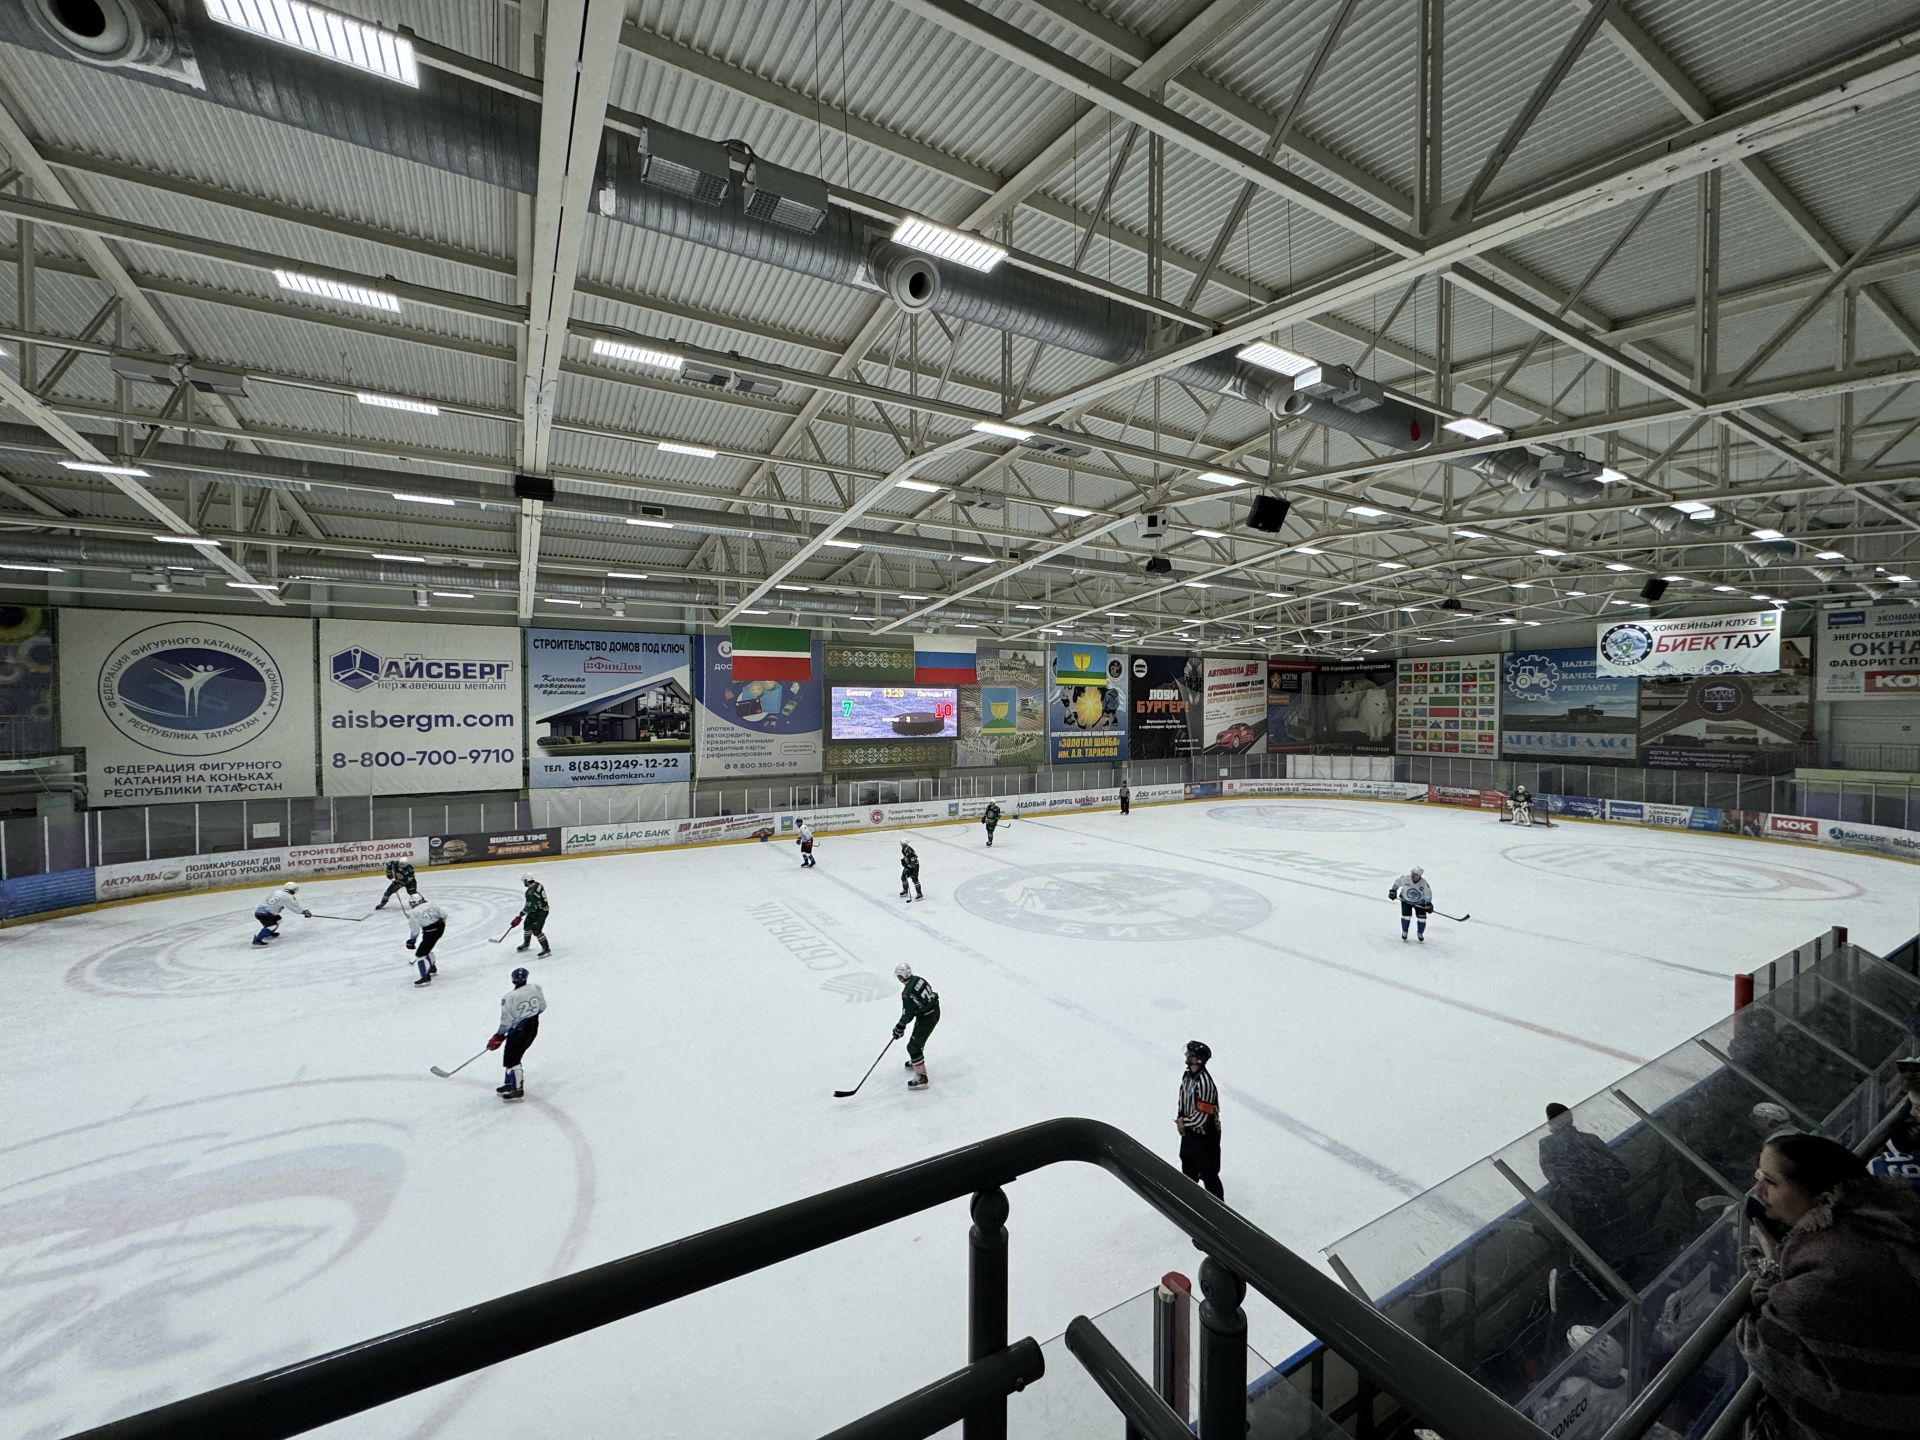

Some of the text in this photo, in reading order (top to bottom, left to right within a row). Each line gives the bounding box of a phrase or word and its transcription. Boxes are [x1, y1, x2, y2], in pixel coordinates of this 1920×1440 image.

[1652, 618, 1757, 632] ХОККЕЙНЫЙ КЛУБ
[533, 638, 685, 654] СТРОИТЕЛЬСТВО ДОМОВ ПОД КЛЮЧ
[1655, 633, 1772, 653] БИЕКТАУ
[1849, 640, 1920, 656] ОКНА
[384, 657, 510, 680] АЙСБЕРГ
[593, 661, 642, 672] ФинДом
[1829, 657, 1896, 668] ФАВОРИТ
[103, 637, 281, 709] ФЕДЕРАЦИЯ ФИГУРНОГО КАТАНИЯ НА КОНЬКАХ
[541, 674, 586, 683] Качество
[1207, 667, 1244, 678] АВТОШКОЛА
[377, 681, 461, 691] нержавеющий
[1208, 683, 1235, 691] АВТОШКОЛА
[1562, 684, 1617, 692] РЕЗУЛЬТАТ
[1149, 689, 1178, 700] ЛОВИ
[842, 700, 953, 718] 7 10
[127, 716, 260, 741] РЕСПУБЛИКА ТАТАРСТАН
[332, 710, 514, 733] aisbergm.com
[332, 748, 514, 768] 8-800-700-9710
[706, 751, 773, 759] рефинансирование
[1058, 750, 1070, 758] ИМ.
[1085, 747, 1118, 757] ТАРАСОВА
[103, 760, 282, 776] ФЕДЕРАЦИЯ ФИГУРНОГО
[544, 758, 679, 773] ТЕЛ. 8(843)249-12-22
[114, 772, 274, 786] КАТАНИЯ НА КОНЬКАХ
[571, 771, 655, 782] www.findomkzn.ru
[103, 782, 283, 798] РЕСПУБЛИКИ ТАТАРСТАН
[1017, 799, 1047, 808] ЛЕДОВЫЙ
[1049, 798, 1072, 806] ДВОРЕЦ
[693, 817, 733, 829] АВТОШКОЛА
[1648, 815, 1687, 825] ДВЕРИ
[490, 835, 525, 844] BURGER
[600, 833, 614, 842] АК
[616, 831, 643, 840] БАРС
[645, 829, 671, 838] БАНК
[1845, 832, 1886, 842] АЙСБЕРГ
[289, 842, 412, 857] СТРОИТЕЛЬСТВО ДОМОВ
[185, 856, 281, 872] ПОЛИКАРБОНАТ ДЛЯ
[298, 855, 359, 866] КОТТЕДЖЕЙ
[361, 853, 381, 861] ПОД
[384, 850, 414, 859] ЗАКАЗ
[100, 871, 163, 888] АКТУАЛЬ!
[185, 864, 281, 881] БОГАТОГО УРОЖАЯ
[743, 901, 849, 971] СБЕРБАНК
[517, 997, 541, 1019] 29
